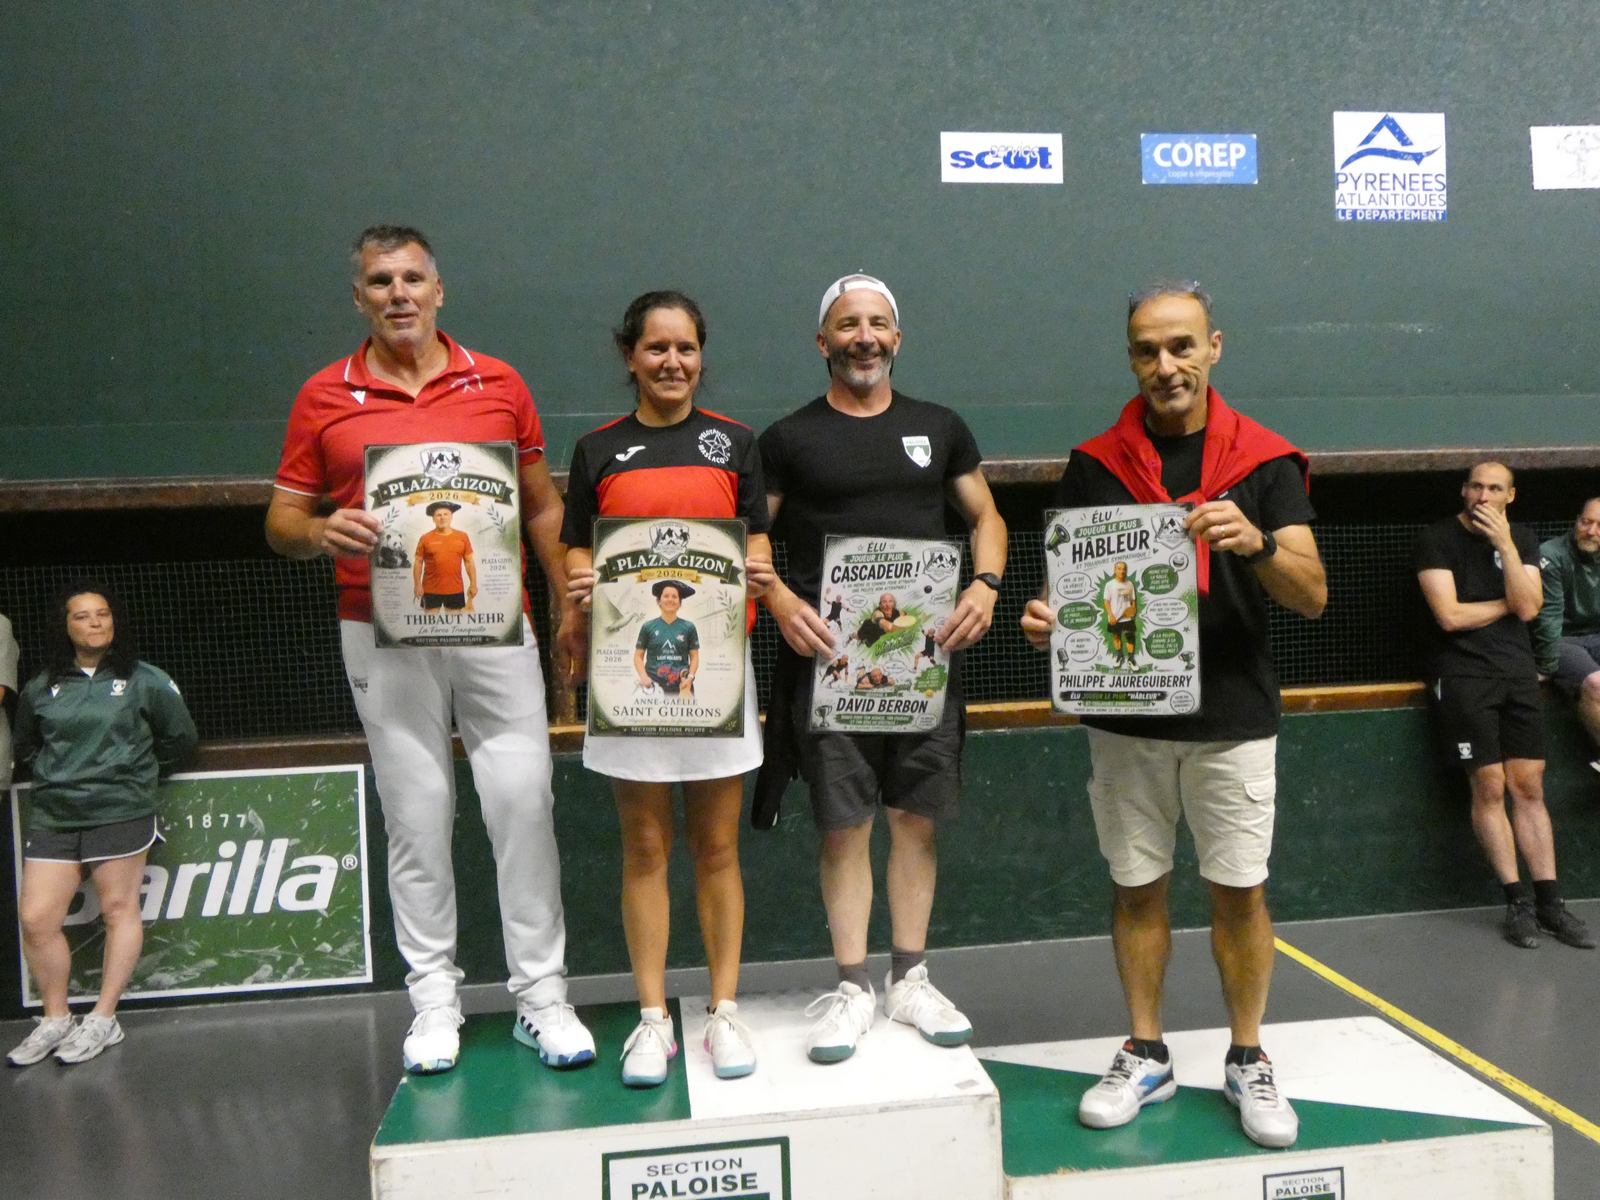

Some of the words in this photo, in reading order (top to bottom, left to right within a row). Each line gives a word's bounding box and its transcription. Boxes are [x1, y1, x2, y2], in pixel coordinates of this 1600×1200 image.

[1153, 142, 1247, 167] COREP
[1336, 193, 1447, 207] ATLANTIQUES
[1338, 209, 1353, 220] LE
[388, 478, 442, 496] PLAZA
[450, 477, 503, 494] GIZON
[429, 492, 459, 500] 2026
[1092, 510, 1112, 524] ÉLU
[1078, 526, 1106, 537] JOUEUR
[1108, 524, 1118, 532] LE
[1119, 520, 1138, 531] PLUS
[1072, 530, 1150, 564] HÂBLEUR
[617, 554, 670, 571] PLAZA
[677, 555, 727, 573] GIZON
[849, 554, 876, 563] JOUEUR
[877, 553, 886, 562] LE
[887, 553, 904, 561] PLUS
[656, 570, 683, 578] 2026
[831, 563, 913, 584] CASCADEUR
[404, 613, 463, 625] THIBAUT
[467, 613, 505, 624] NEHR
[1059, 675, 1106, 688] PHILIPPE
[1109, 676, 1193, 688] JAUREGUIBERRY
[613, 706, 653, 717] SAINT
[659, 706, 721, 717] GUIRONS
[836, 698, 875, 712] DAVID
[878, 699, 928, 713] BERBON
[186, 813, 247, 829] 1877
[646, 1157, 743, 1177] SECTION
[631, 1172, 758, 1200] PALOISE
[1282, 1177, 1324, 1186] SECTION
[1276, 1183, 1331, 1197] PALOISE
